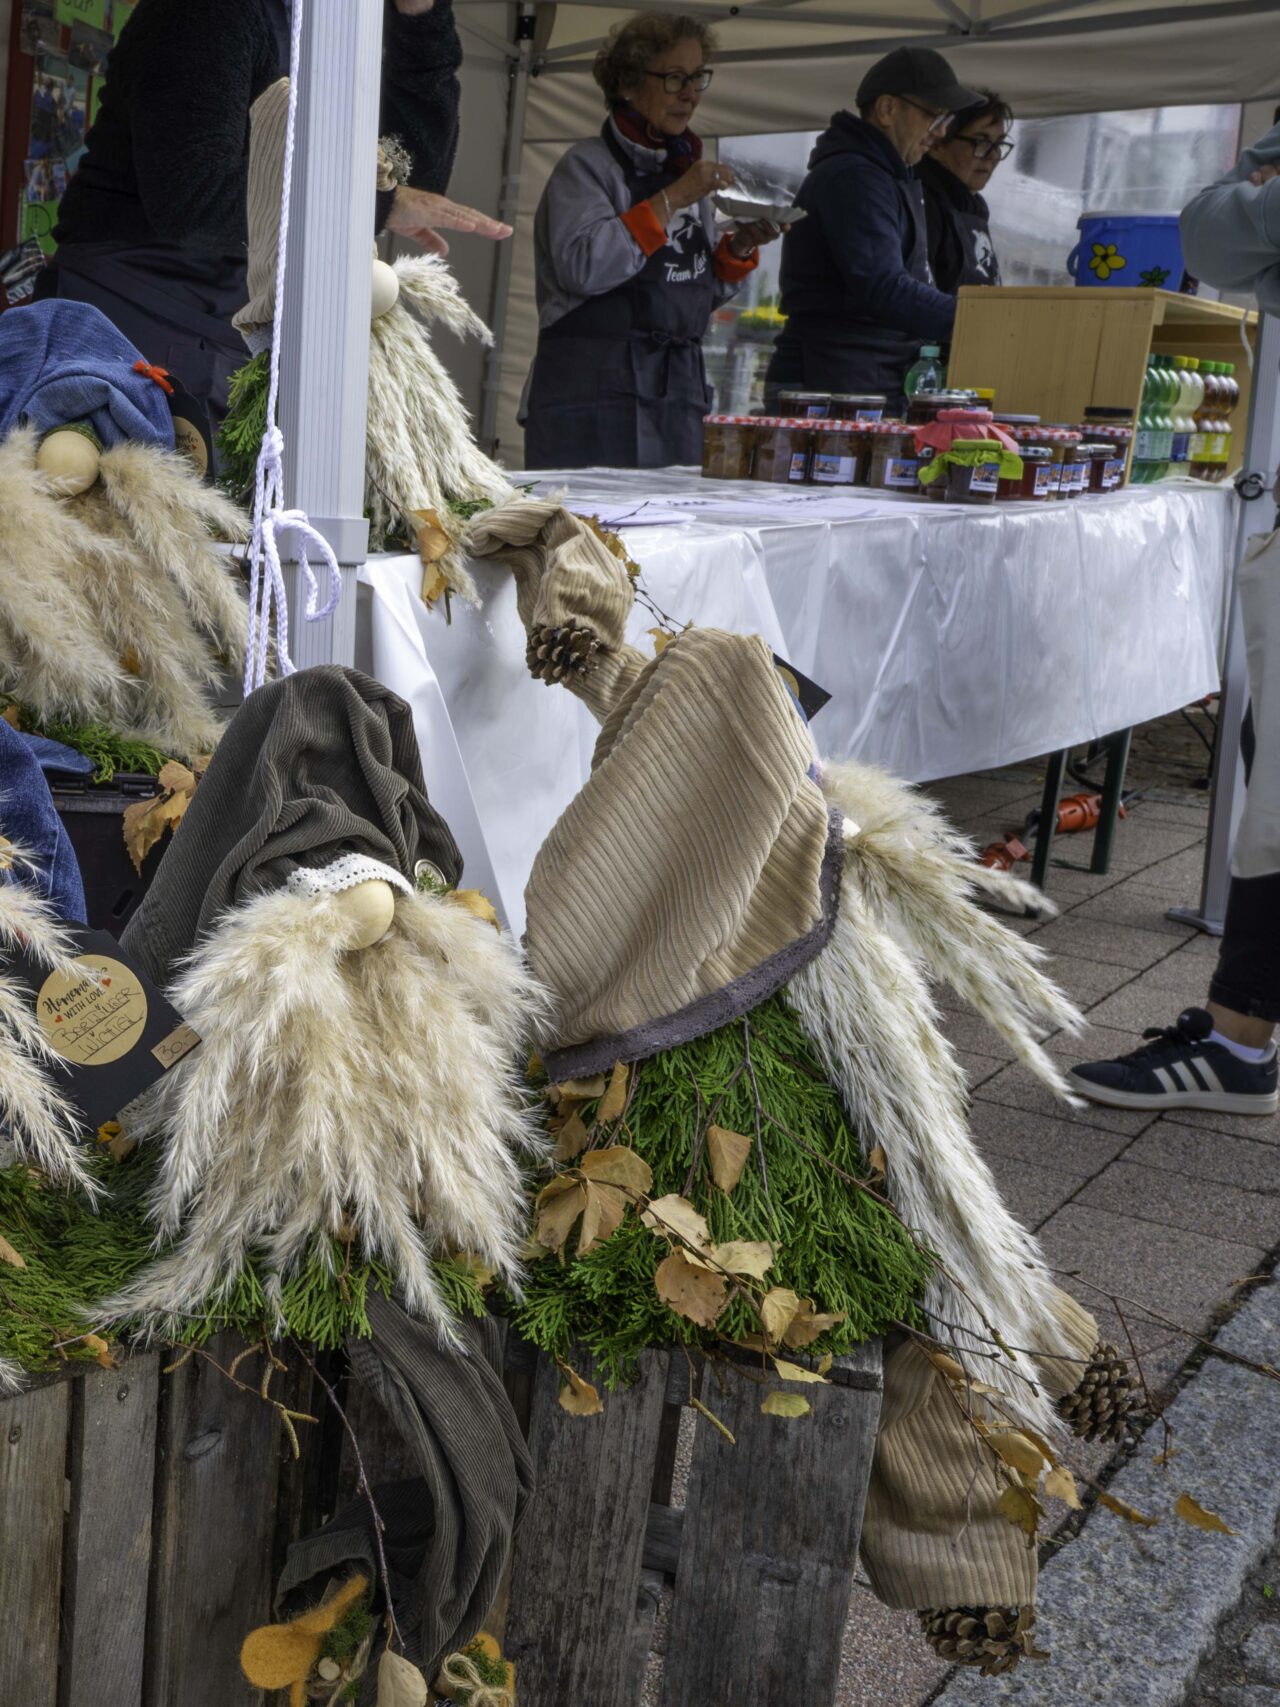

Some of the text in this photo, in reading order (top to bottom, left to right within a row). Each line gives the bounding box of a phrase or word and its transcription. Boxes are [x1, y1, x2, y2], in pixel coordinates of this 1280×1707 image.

[664, 262, 691, 282] Team
[43, 966, 108, 1015] Homema
[63, 987, 106, 1019] WITH LOVE
